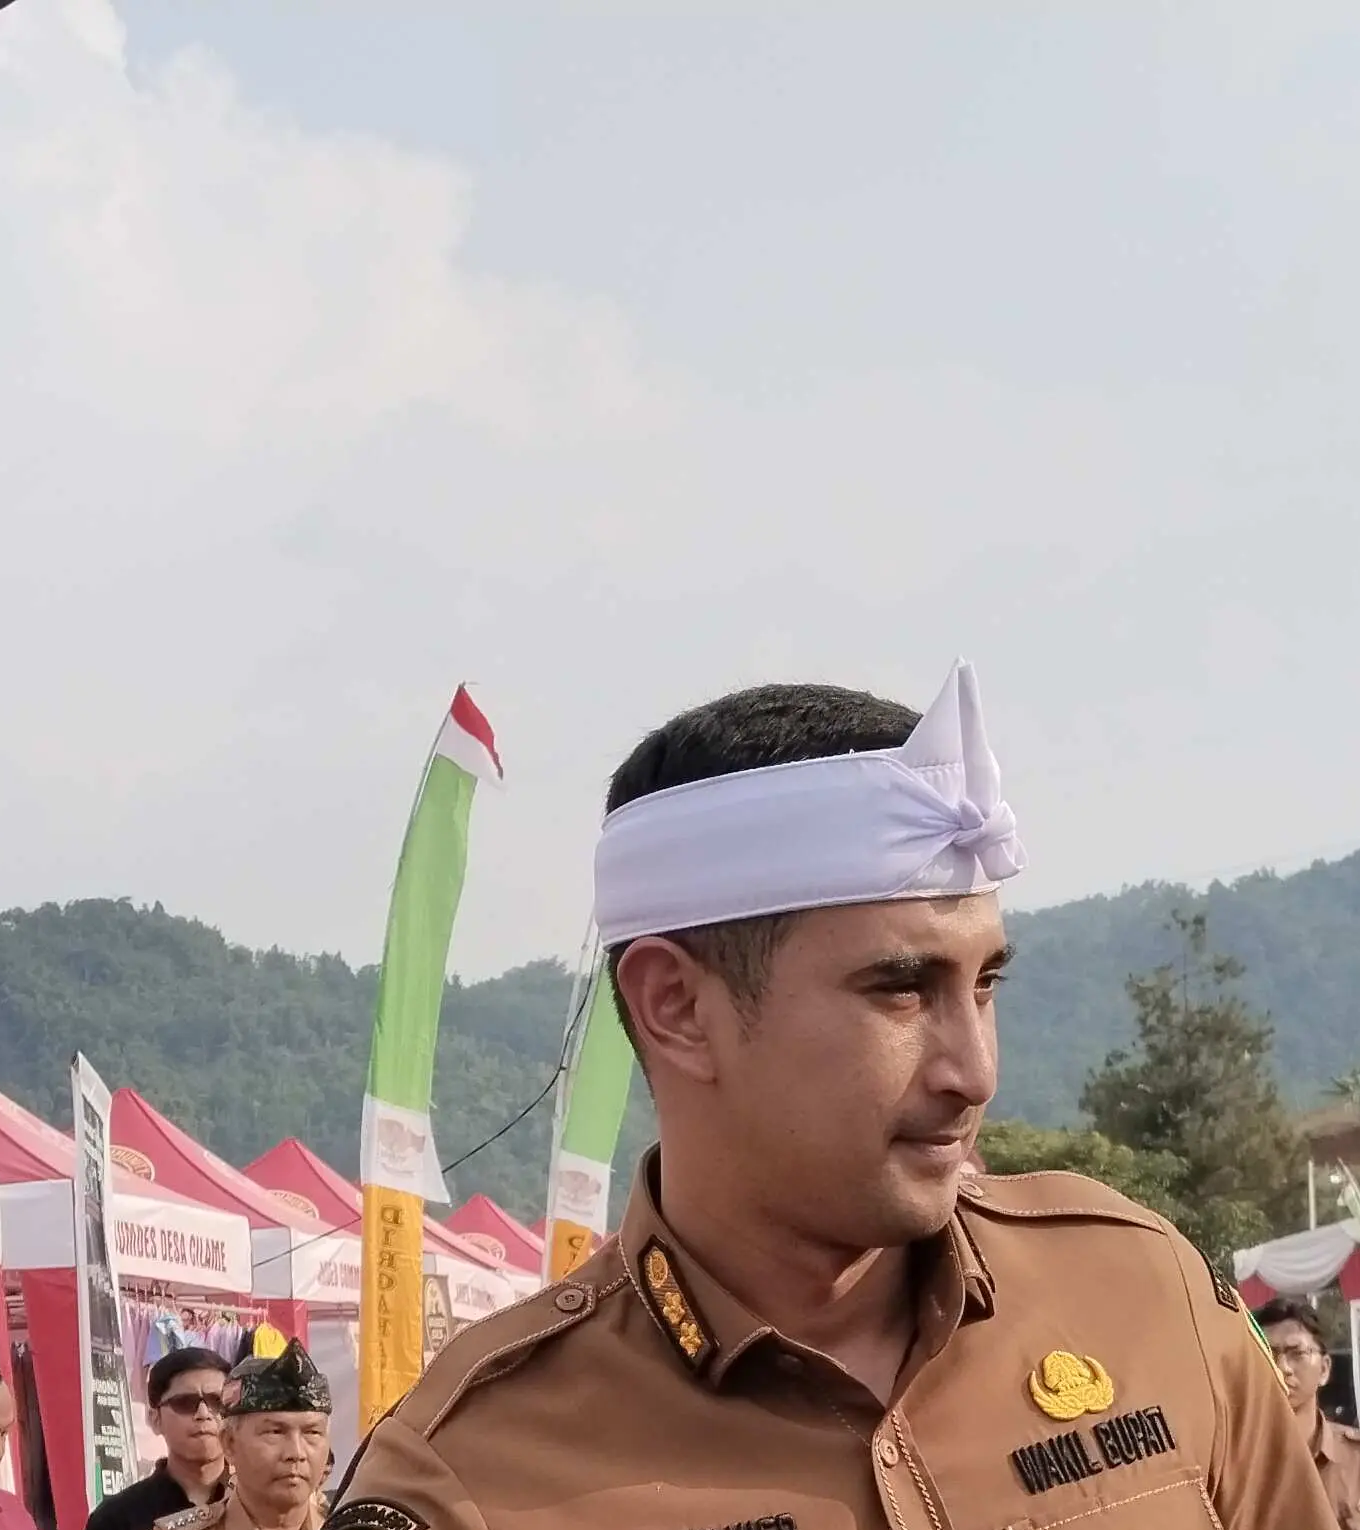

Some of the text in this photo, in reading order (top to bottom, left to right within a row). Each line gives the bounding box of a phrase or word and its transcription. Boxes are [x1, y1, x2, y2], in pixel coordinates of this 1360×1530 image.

[160, 1228, 188, 1266] DESA
[189, 1232, 228, 1274] CILAME
[1010, 1405, 1177, 1495] WAKIL BUPATI
